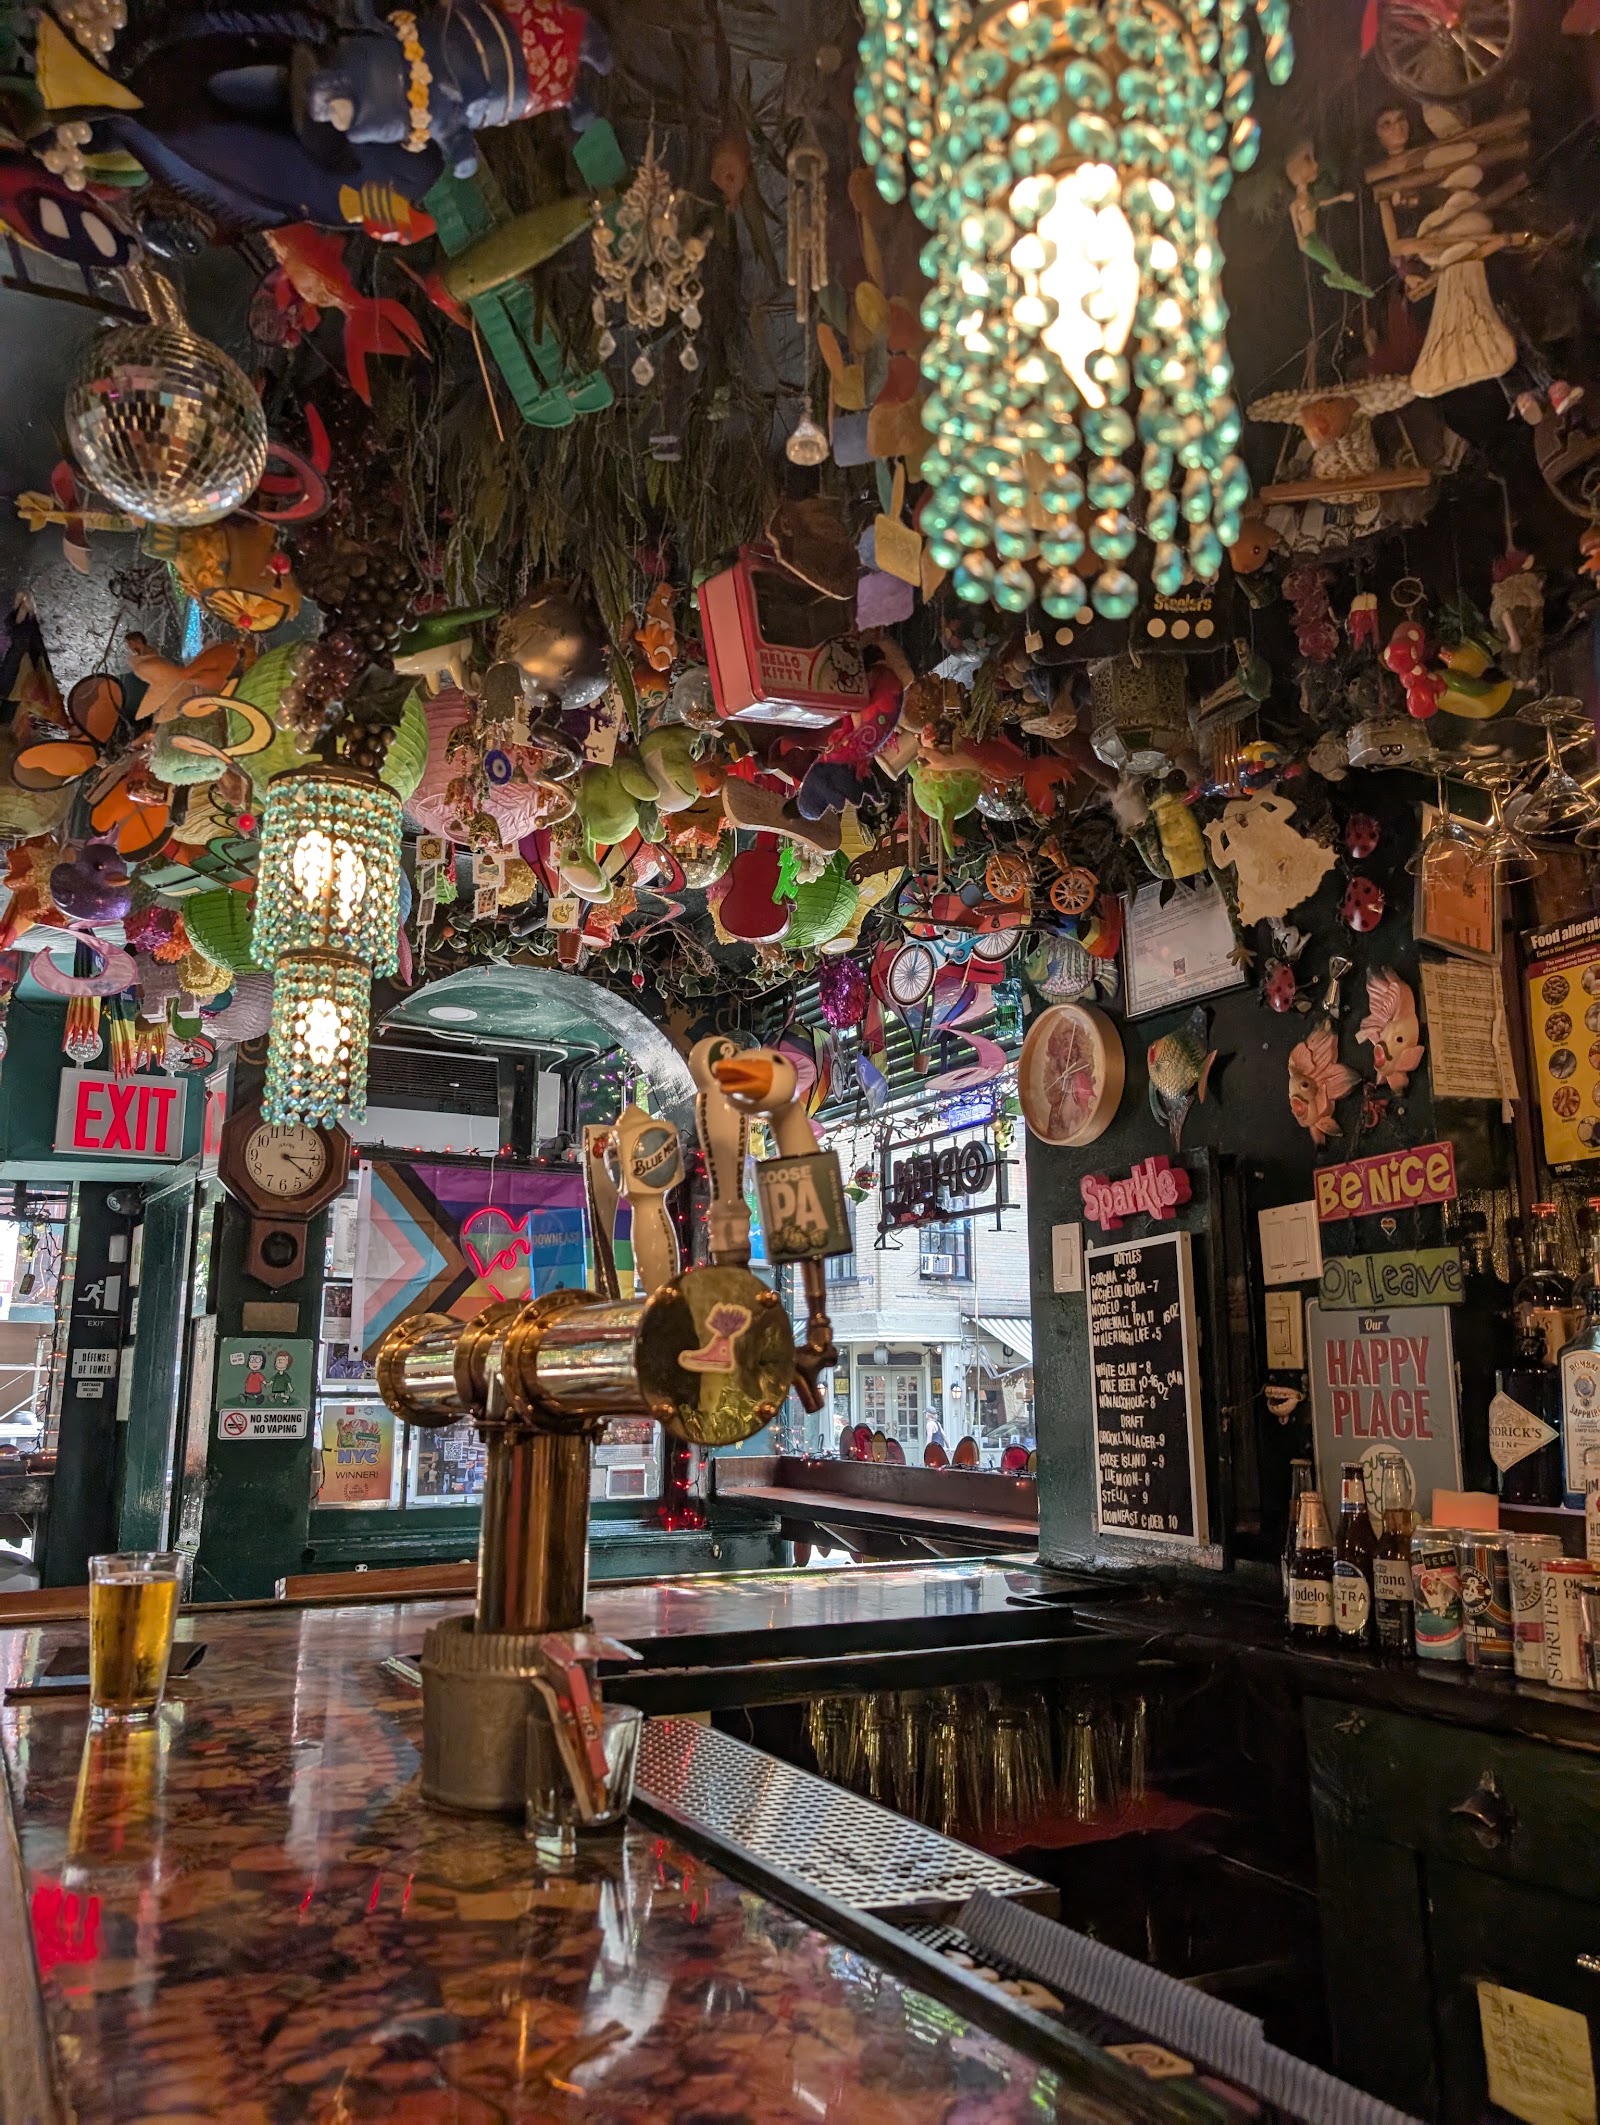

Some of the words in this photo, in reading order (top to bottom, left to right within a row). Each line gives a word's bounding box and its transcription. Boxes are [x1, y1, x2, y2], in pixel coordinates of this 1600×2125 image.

[760, 651, 801, 669] HELLO
[762, 666, 802, 682] KITTY
[1530, 929, 1560, 949] Food
[1561, 916, 1600, 941] allergi
[74, 1080, 177, 1153] EXIT
[271, 1127, 279, 1138] 11
[283, 1124, 294, 1136] 12
[300, 1129, 305, 1141] 1
[257, 1135, 269, 1148] 10
[309, 1139, 317, 1151] 2
[251, 1149, 258, 1161] 9
[312, 1154, 320, 1166] 3
[254, 1162, 262, 1175] 8
[306, 1167, 314, 1179] 4
[633, 1155, 663, 1177] BLUE
[267, 1174, 274, 1187] 7
[280, 1179, 287, 1191] 6
[294, 1177, 301, 1189] 5
[1081, 1156, 1179, 1231] Sparkle
[1317, 1171, 1363, 1217] Be
[1114, 1249, 1142, 1267] BOTTLES
[1091, 1270, 1118, 1286] CORONA
[1320, 1259, 1362, 1303] Or
[1366, 1256, 1463, 1304] Leave
[1092, 1284, 1123, 1303] MICHELOB
[1124, 1281, 1146, 1297] ULTRA
[1092, 1300, 1119, 1317] MODELO
[1093, 1315, 1132, 1333] STONEWALL
[1132, 1312, 1147, 1326] IPA
[1365, 1319, 1383, 1331] Our
[1134, 1326, 1150, 1343] LIFE
[82, 1352, 110, 1363] DÉFENSE
[1325, 1336, 1430, 1388] HAPPY
[89, 1365, 112, 1375] FUMER
[1096, 1363, 1115, 1378] WHITE
[1118, 1362, 1137, 1377] CLAW
[1118, 1378, 1137, 1392] BEER
[1167, 1370, 1183, 1387] CAN
[250, 1414, 262, 1423] NO
[263, 1414, 302, 1423] SMOKING
[1332, 1389, 1433, 1441] PLACE
[1570, 1404, 1600, 1419] SAPPHIR
[1120, 1414, 1144, 1428] DRAFT
[253, 1425, 265, 1434] NO
[267, 1425, 297, 1434] VAPING
[1490, 1426, 1542, 1439] NDRICK'S
[337, 1447, 379, 1465] NYC
[1100, 1452, 1120, 1468] GOOSE
[1121, 1453, 1147, 1468] ISLAND
[335, 1471, 378, 1479] WINNER!
[1102, 1487, 1129, 1505] STELLA
[1103, 1509, 1138, 1526] DOWNEAST
[1141, 1514, 1164, 1530] CIDER
[1168, 1514, 1178, 1529] 10
[1424, 1554, 1455, 1566] BEER
[1510, 1553, 1539, 1573] CLAW
[1293, 1585, 1325, 1602] odelo
[1335, 1590, 1367, 1602] LTRA
